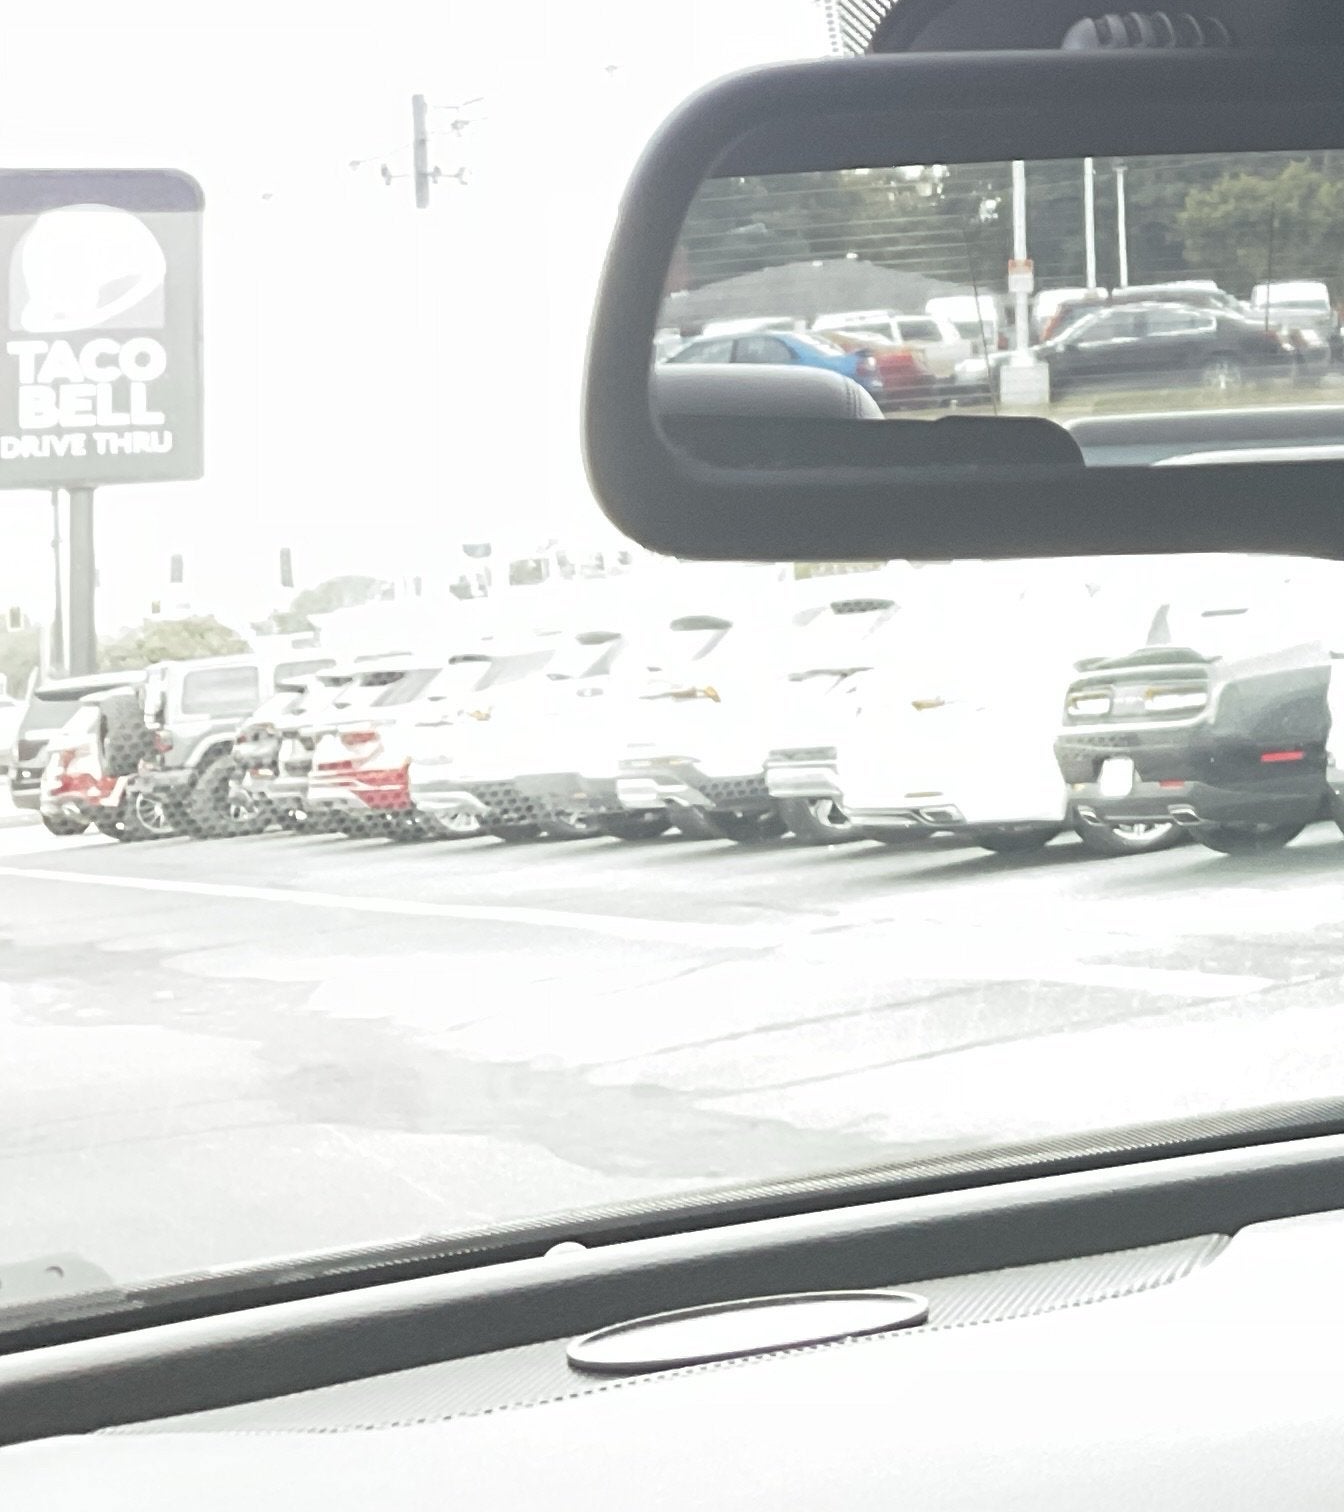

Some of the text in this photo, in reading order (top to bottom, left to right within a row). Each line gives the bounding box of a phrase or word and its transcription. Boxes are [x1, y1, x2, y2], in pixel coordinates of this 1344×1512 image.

[7, 337, 167, 384] TACO
[19, 382, 165, 429] BELL
[0, 431, 173, 459] DRIVE THRU
